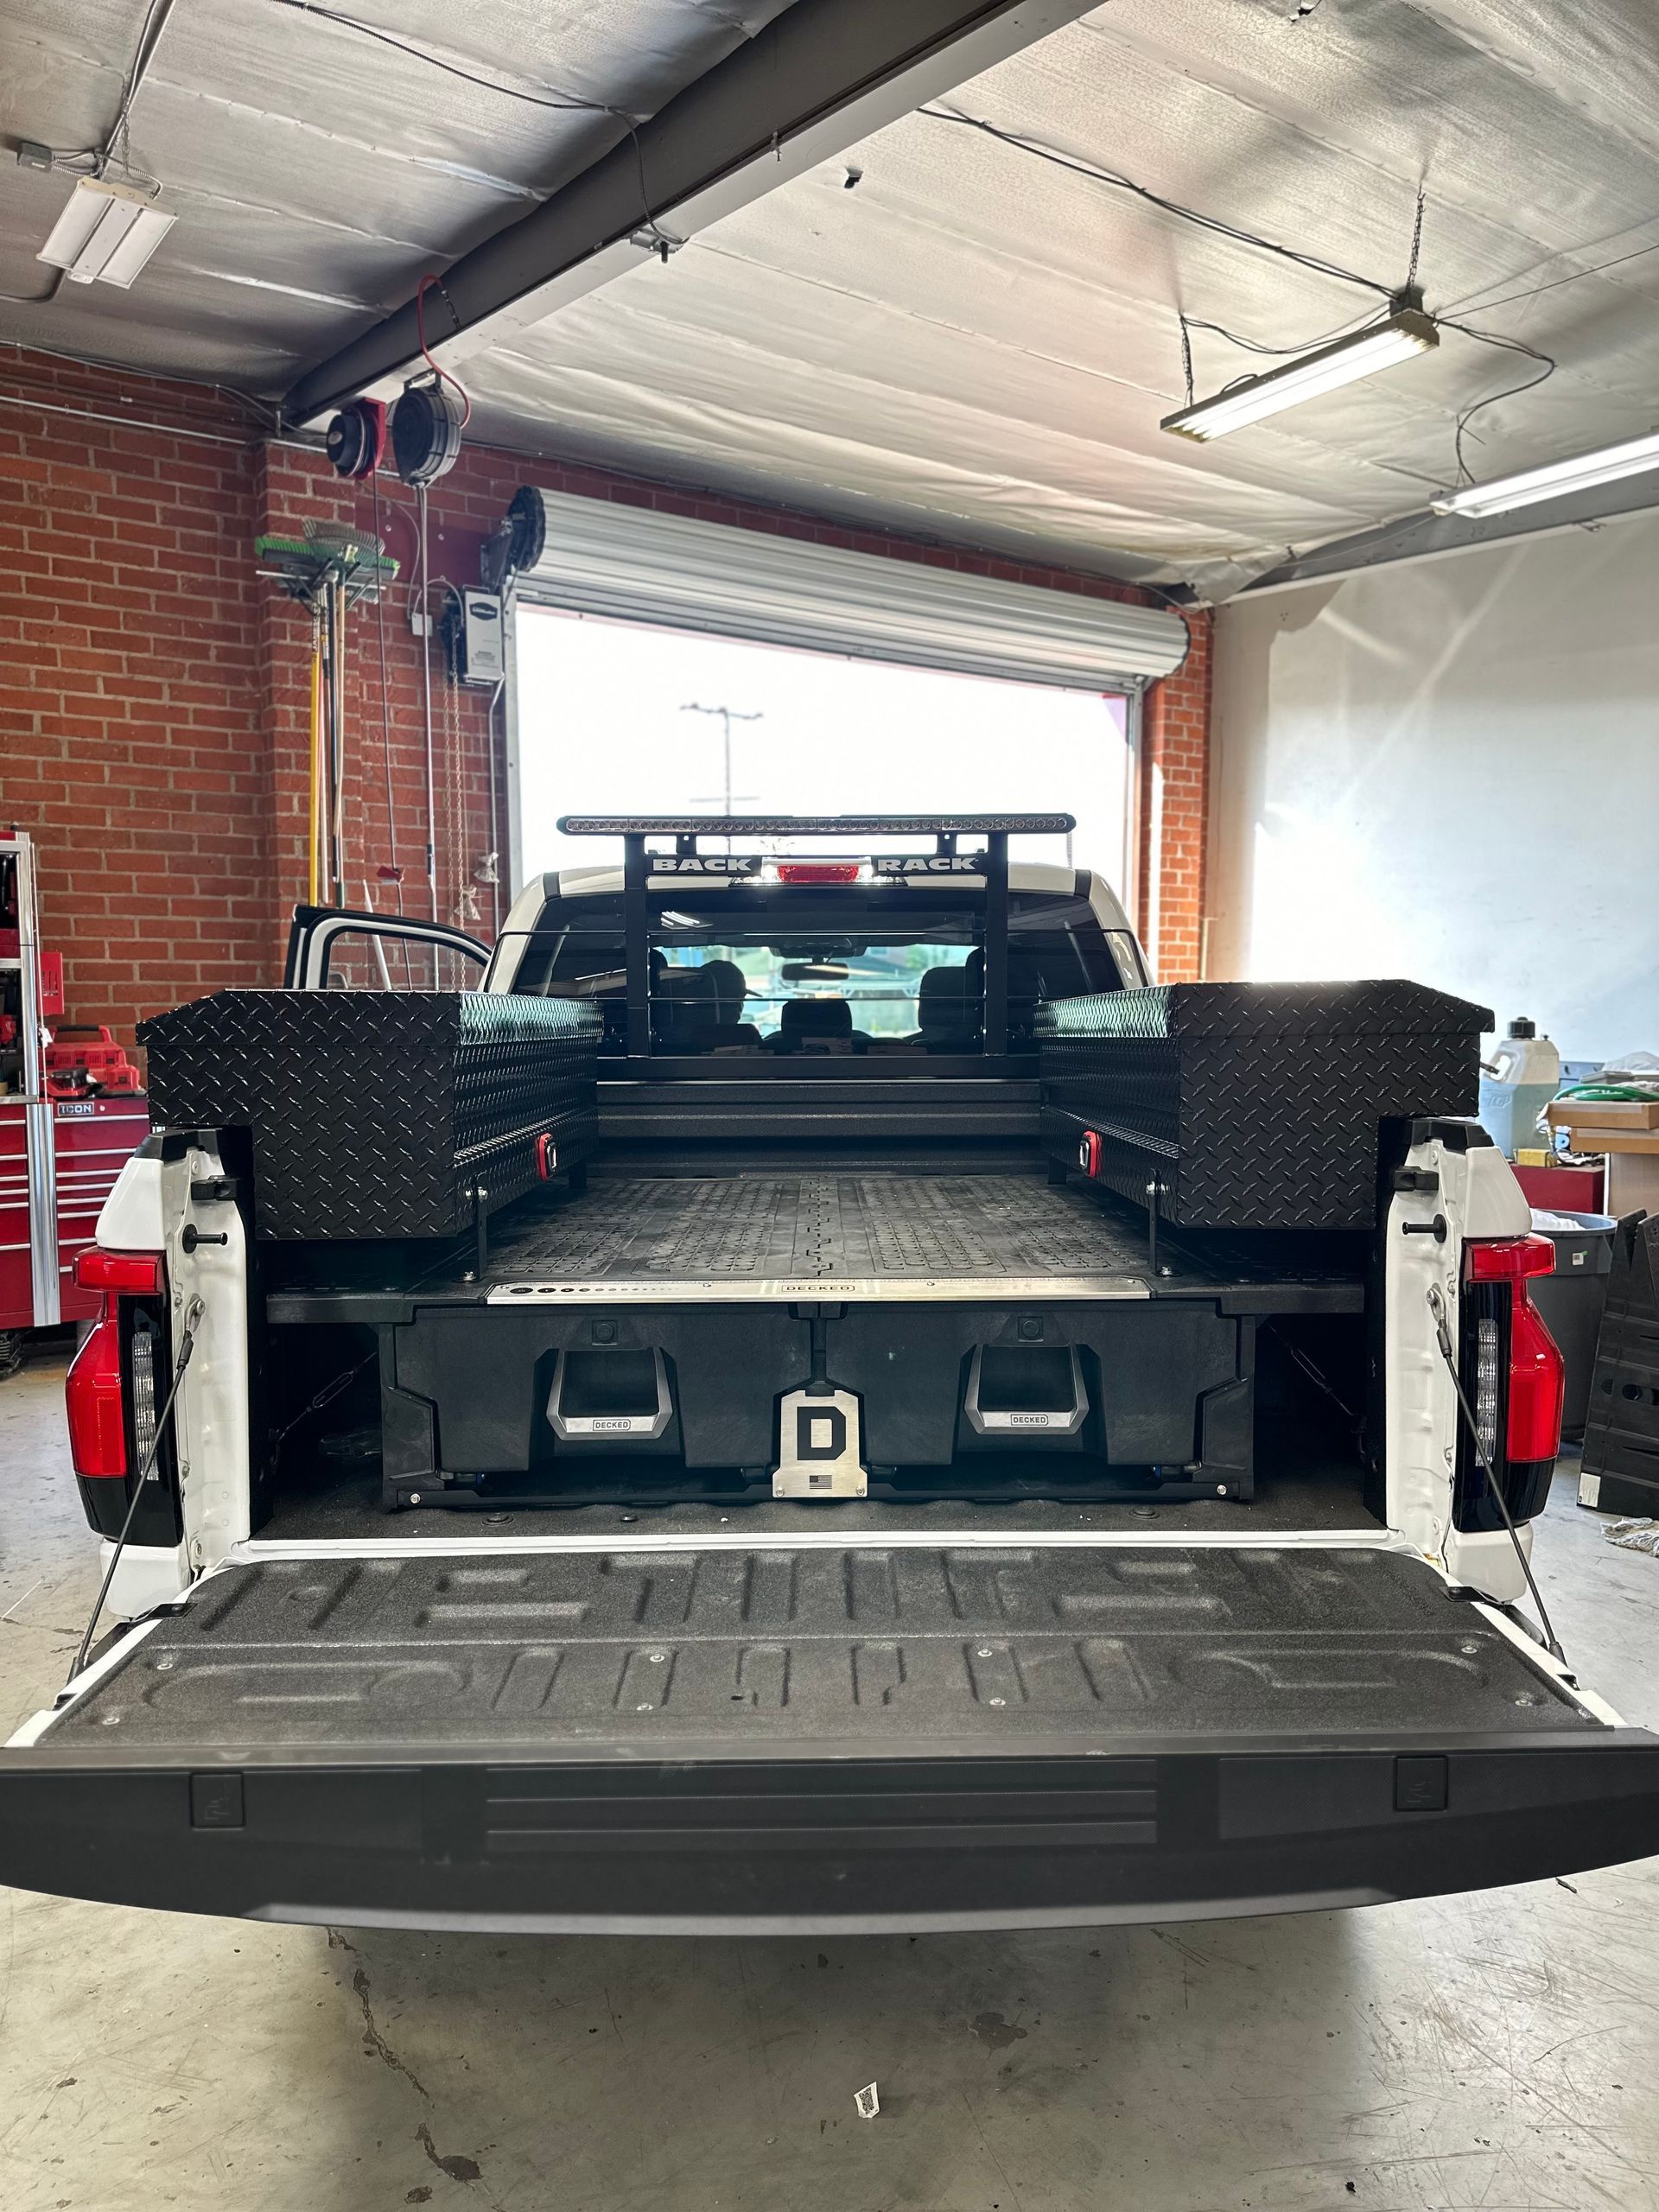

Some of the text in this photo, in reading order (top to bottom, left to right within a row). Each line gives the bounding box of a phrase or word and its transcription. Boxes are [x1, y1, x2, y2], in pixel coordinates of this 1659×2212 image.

[653, 857, 976, 872] BACK RACK
[60, 1104, 92, 1114] ICON
[797, 1406, 847, 1460] D
